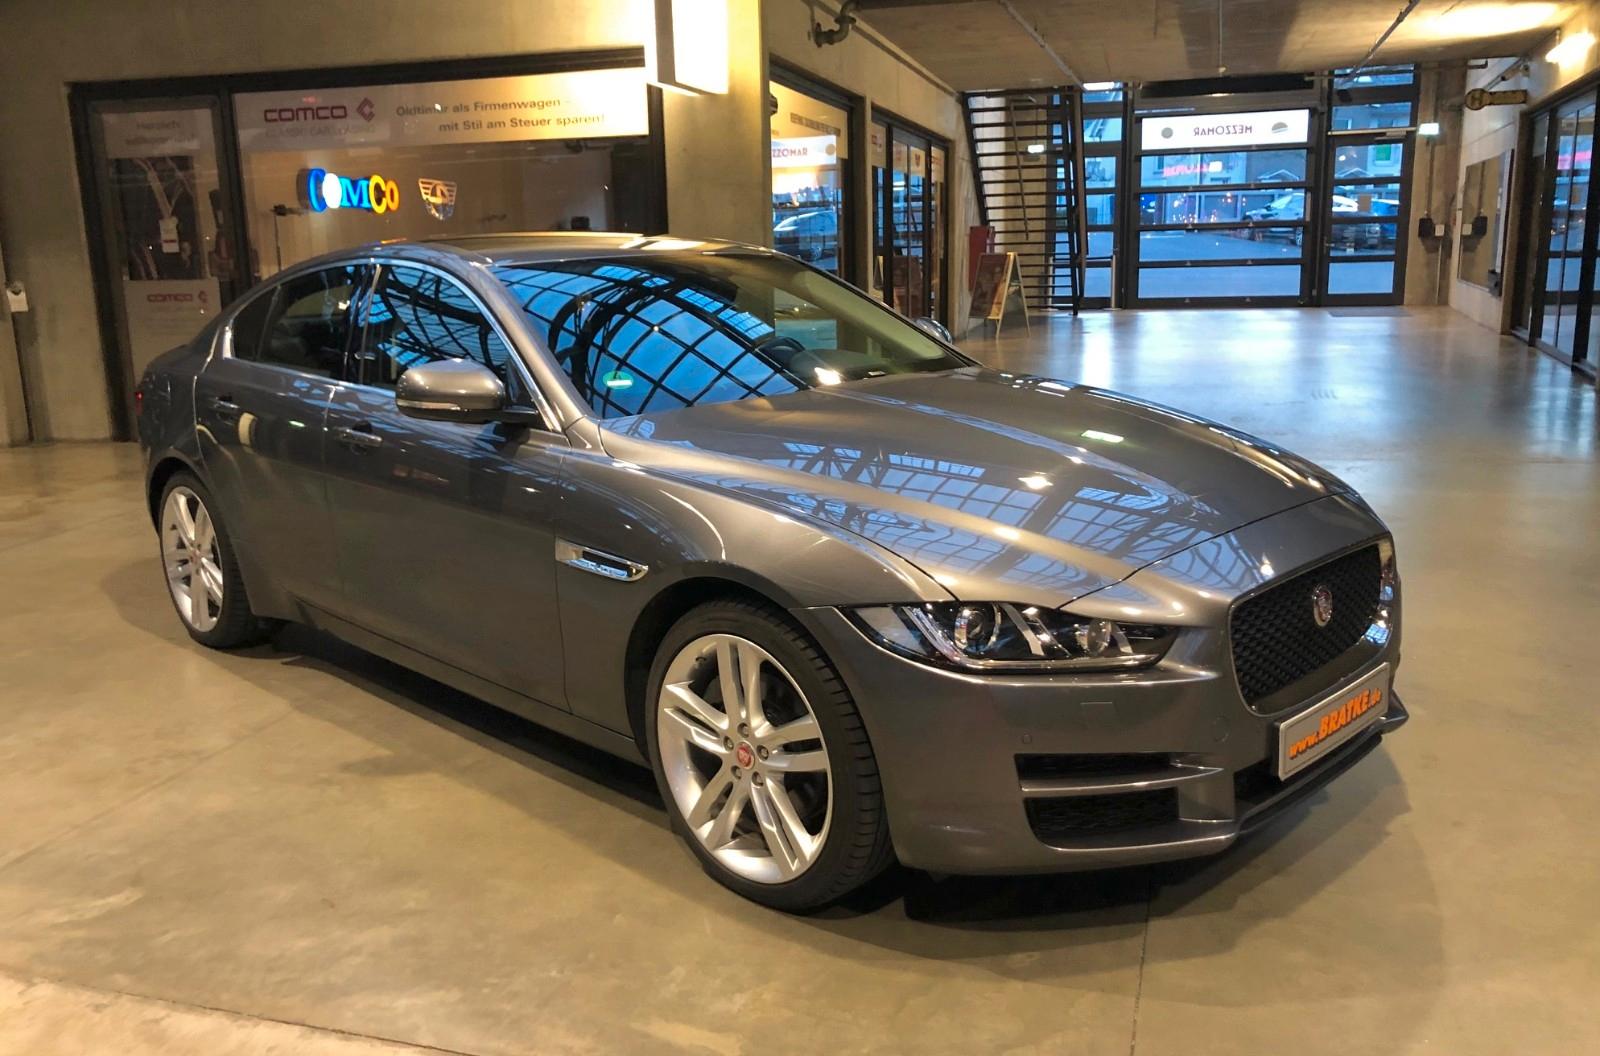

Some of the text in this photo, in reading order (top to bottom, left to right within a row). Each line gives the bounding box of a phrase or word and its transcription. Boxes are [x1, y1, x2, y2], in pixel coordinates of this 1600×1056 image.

[263, 105, 348, 124] comco
[452, 103, 470, 114] als
[473, 98, 561, 113] Firmenwagen
[438, 113, 605, 132] mit Stil am Steuer sparen!
